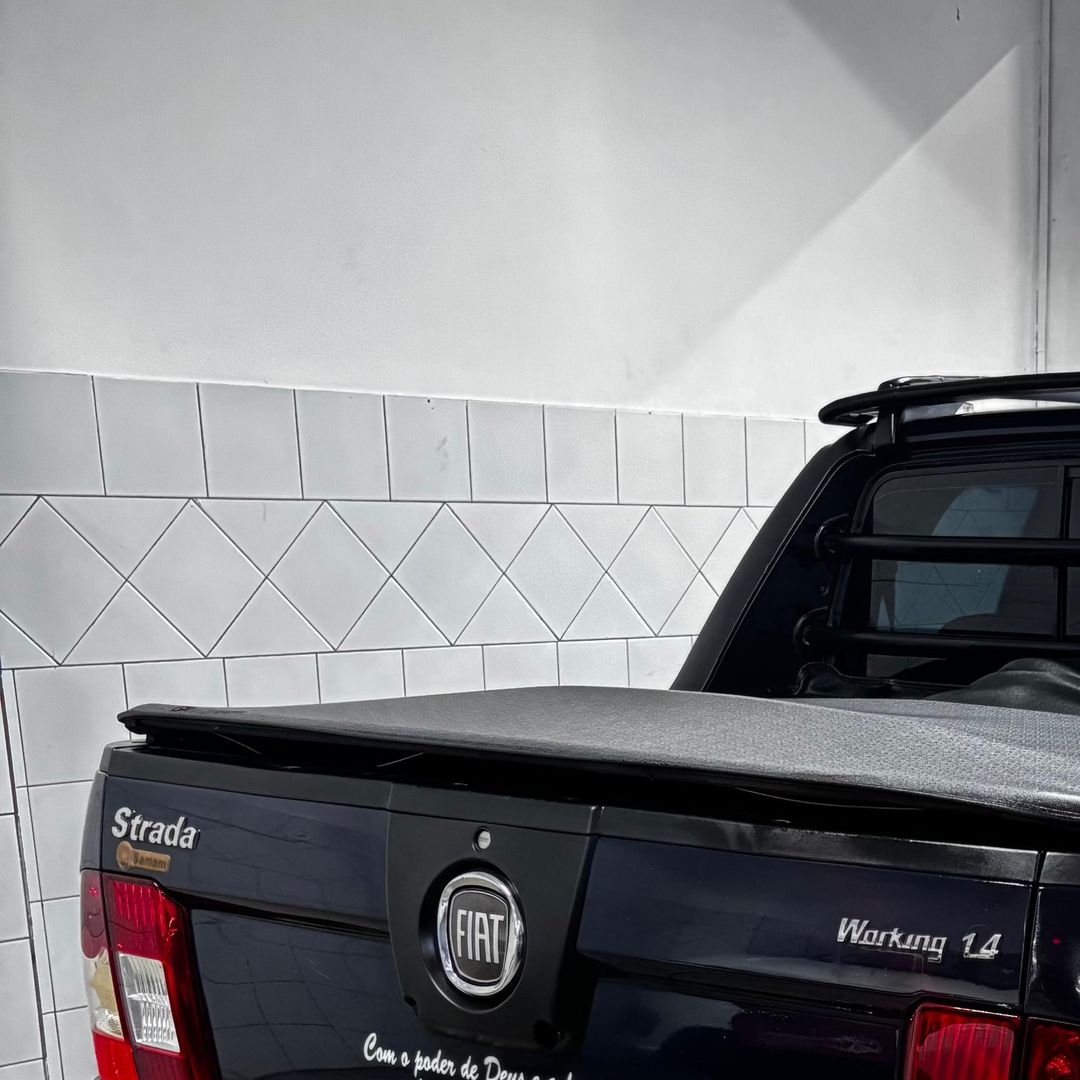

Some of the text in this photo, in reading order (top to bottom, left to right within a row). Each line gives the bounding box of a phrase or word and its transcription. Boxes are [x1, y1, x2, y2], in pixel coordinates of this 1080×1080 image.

[112, 806, 198, 849] Strada
[456, 908, 505, 964] FIAT
[837, 917, 948, 963] Working
[363, 1032, 397, 1066] Com
[401, 1050, 411, 1068] o
[414, 1049, 456, 1077] poder
[460, 1055, 480, 1080] de
